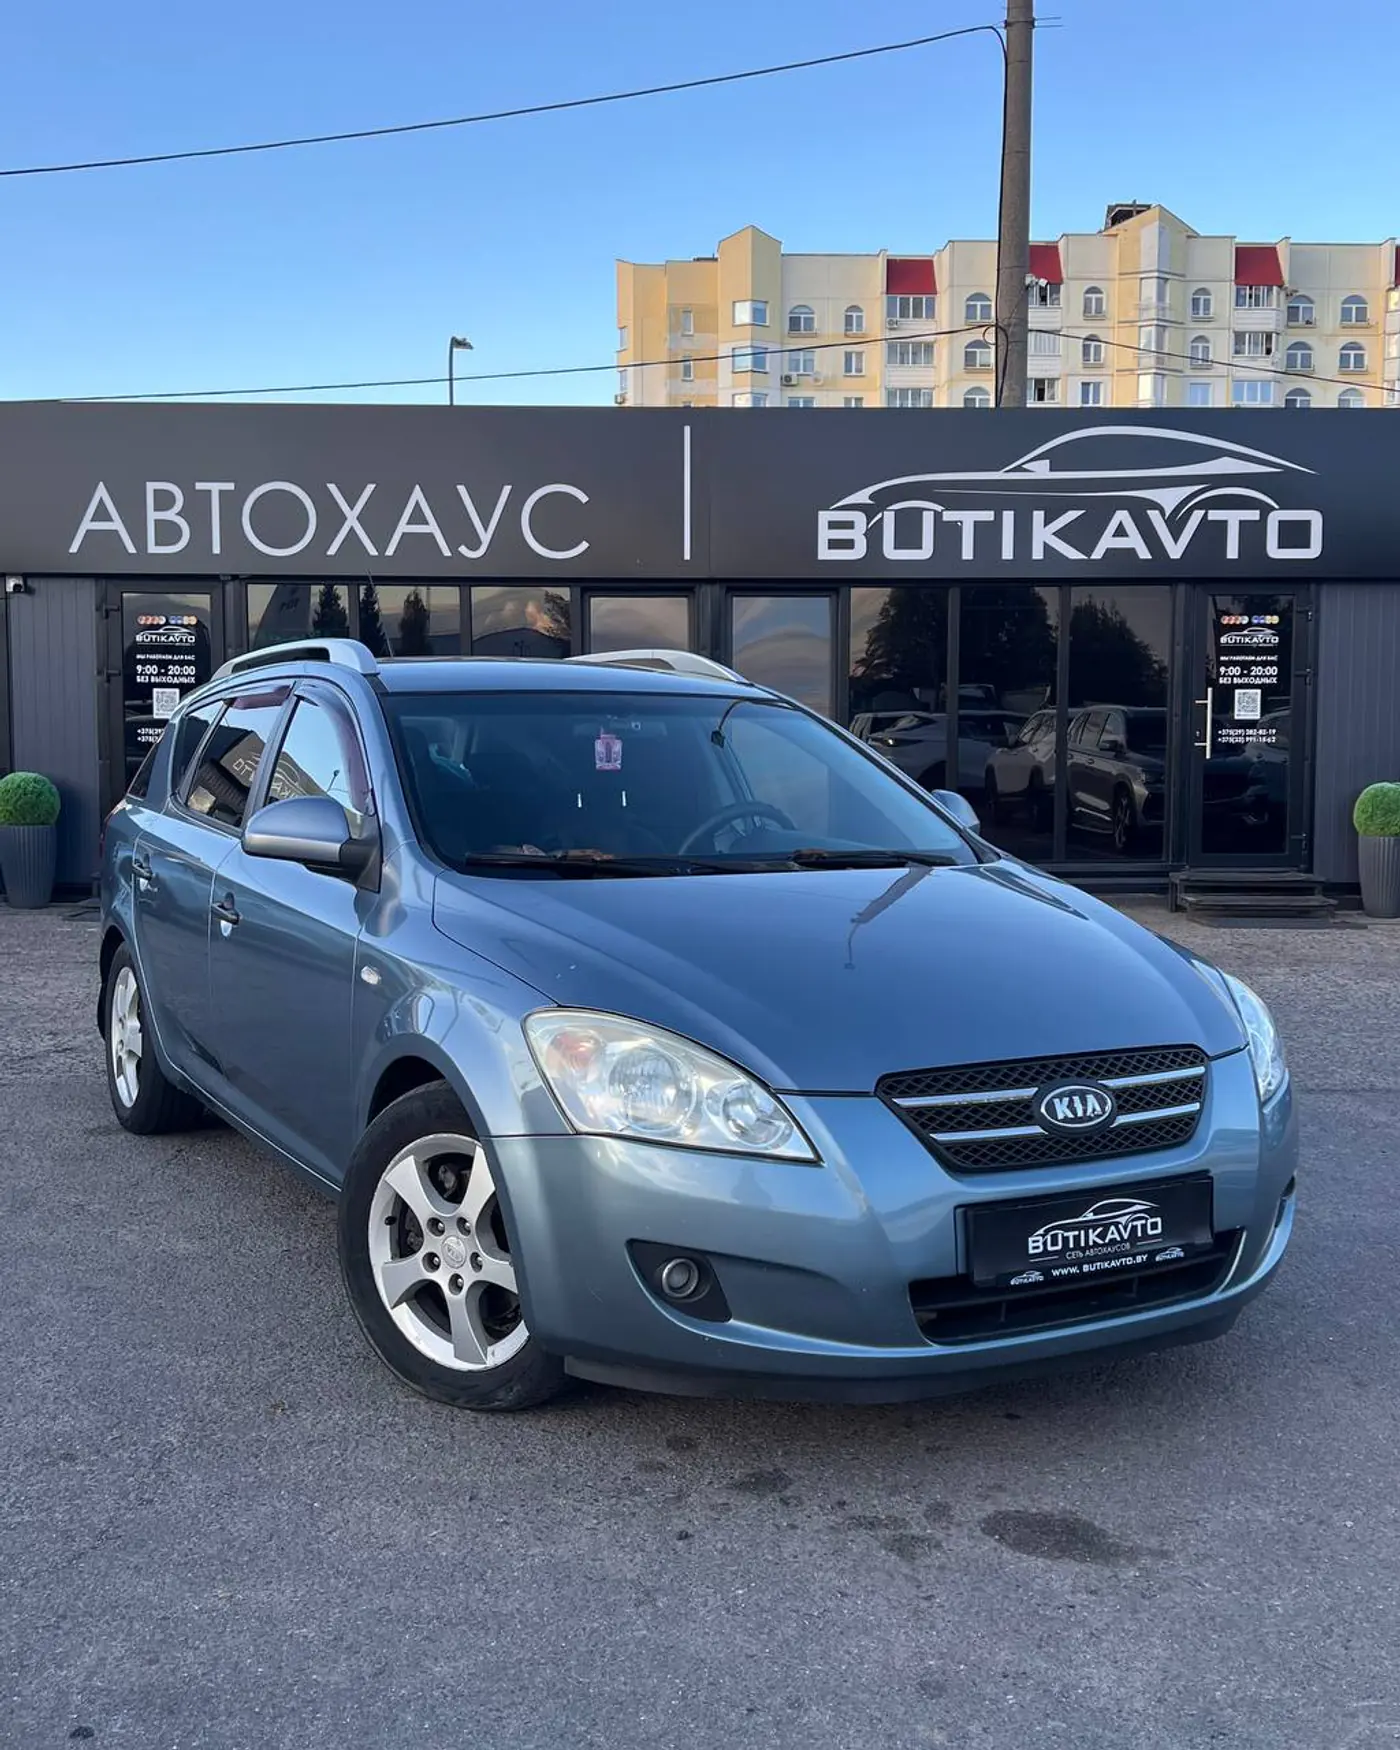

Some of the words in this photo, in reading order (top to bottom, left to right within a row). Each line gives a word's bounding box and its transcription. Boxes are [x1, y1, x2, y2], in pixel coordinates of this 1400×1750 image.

[68, 481, 590, 559] АВТОХАУС
[817, 509, 1324, 560] BUTIKAVTO
[136, 634, 195, 643] BUTIKAVTO
[136, 665, 158, 675] 9:00
[168, 665, 196, 675] 20:00
[1220, 666, 1241, 676] 9:00
[1250, 666, 1278, 676] 20:00
[150, 676, 196, 684] ВЫХОДНЫХ
[1052, 1094, 1103, 1120] KIA
[1028, 1217, 1162, 1254] BUTIKAVTO
[1066, 1250, 1083, 1260] СЕТЬ
[1085, 1243, 1130, 1259] АВТОХАУСОВ
[1082, 1254, 1148, 1273] BUTIKAVTO.BY
